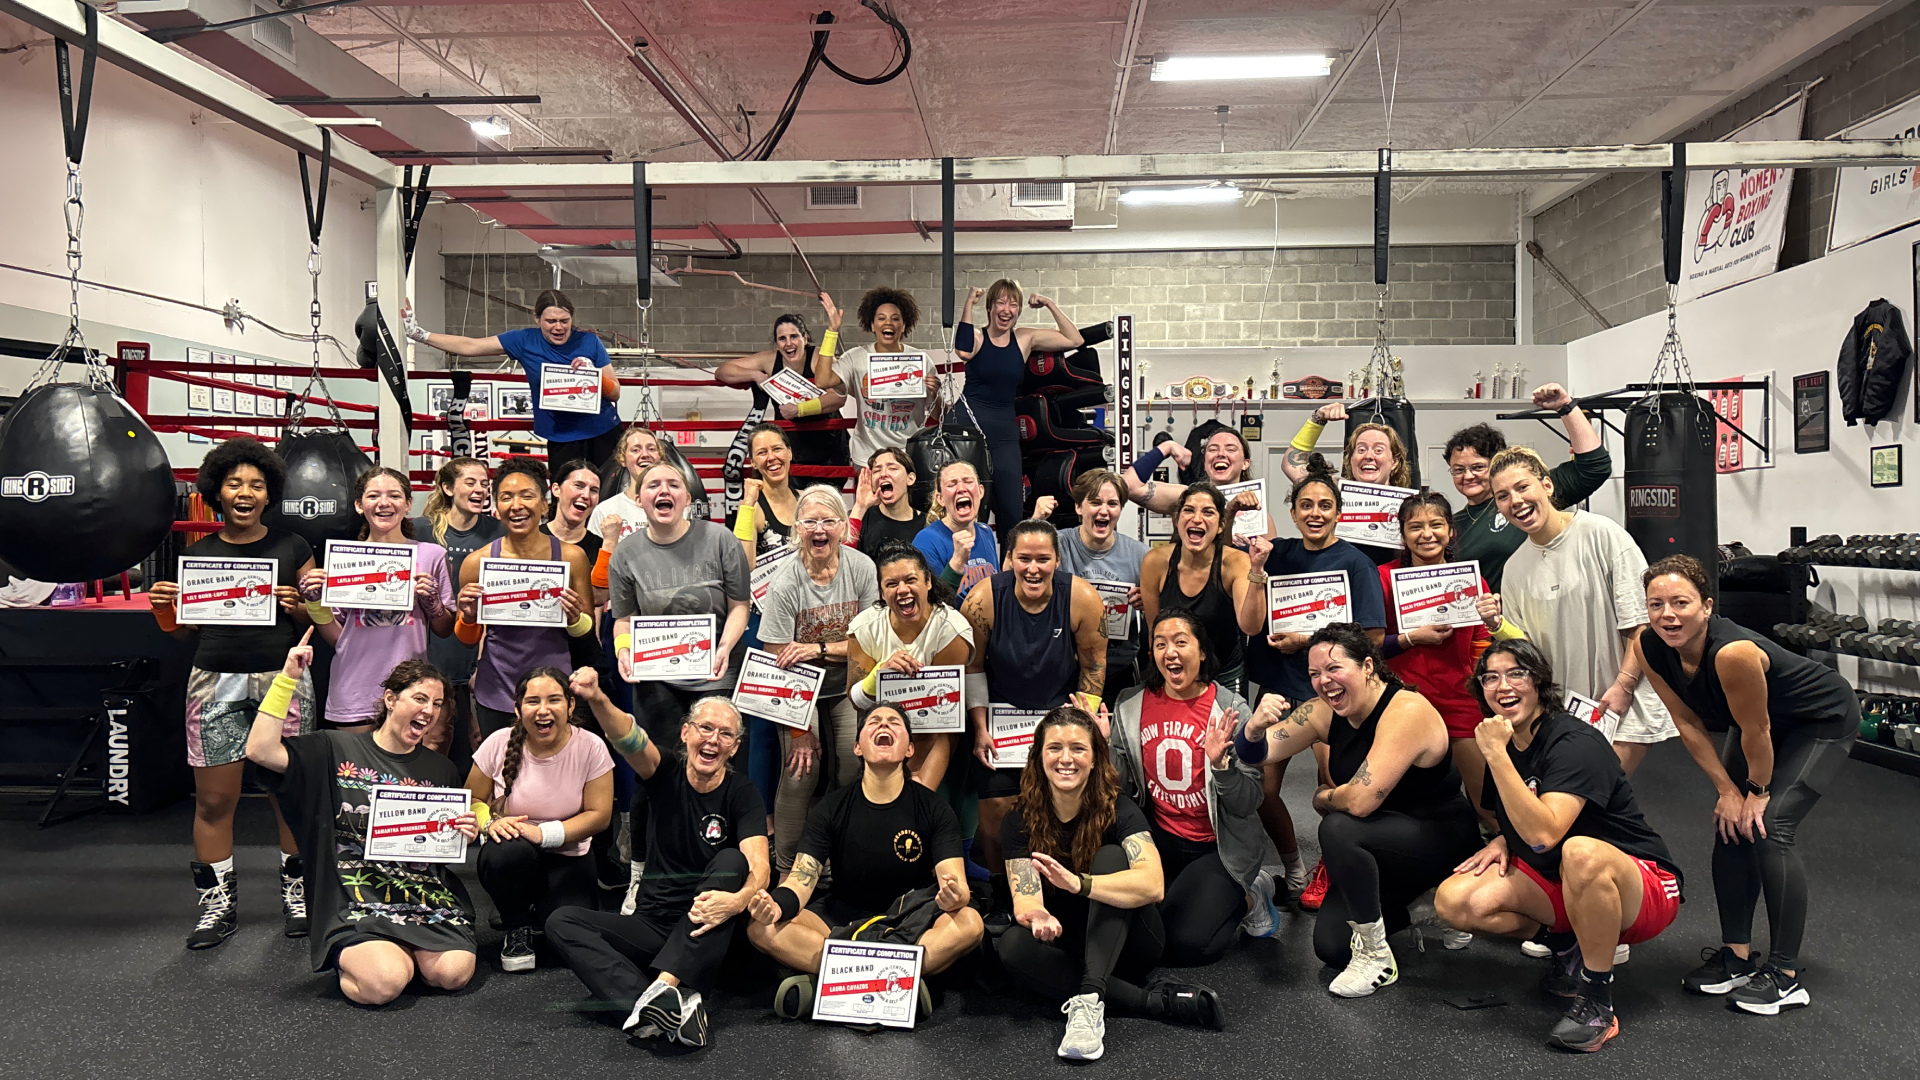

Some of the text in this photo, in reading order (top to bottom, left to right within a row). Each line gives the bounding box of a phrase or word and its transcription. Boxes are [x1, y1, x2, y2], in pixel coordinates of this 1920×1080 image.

[1870, 167, 1912, 195] GIRLS'
[1736, 189, 1773, 225] BOXING
[1730, 220, 1755, 248] CLUB
[1709, 264, 1723, 274] MARTIAL
[1724, 262, 1732, 270] ARTS
[1740, 253, 1753, 263] WOMEN
[122, 349, 145, 360] RINGSIDE
[1122, 320, 1130, 465] RINGSIDE
[872, 402, 884, 411] NBA
[677, 432, 696, 444] EXIT
[4, 478, 71, 495] RING R SIDE
[1344, 486, 1372, 494] CERTIFICATE
[1630, 488, 1676, 508] RINGSIDE
[285, 501, 334, 514] RING R SIDE
[187, 577, 214, 586] ORANGE
[487, 579, 510, 587] ORANGE
[1401, 582, 1442, 597] PURPLE BAND
[1275, 590, 1313, 603] PURPLE BAND
[638, 636, 660, 645] YELLOW
[747, 671, 769, 679] ORANGE
[884, 687, 907, 697] YELLOW
[1164, 721, 1194, 739] FIRM
[107, 709, 129, 806] LAUNDRY
[379, 809, 404, 818] YELLOW
[831, 947, 866, 955] CERTIFICATE
[877, 950, 914, 959] COMPLETION
[832, 966, 853, 974] BLACK
